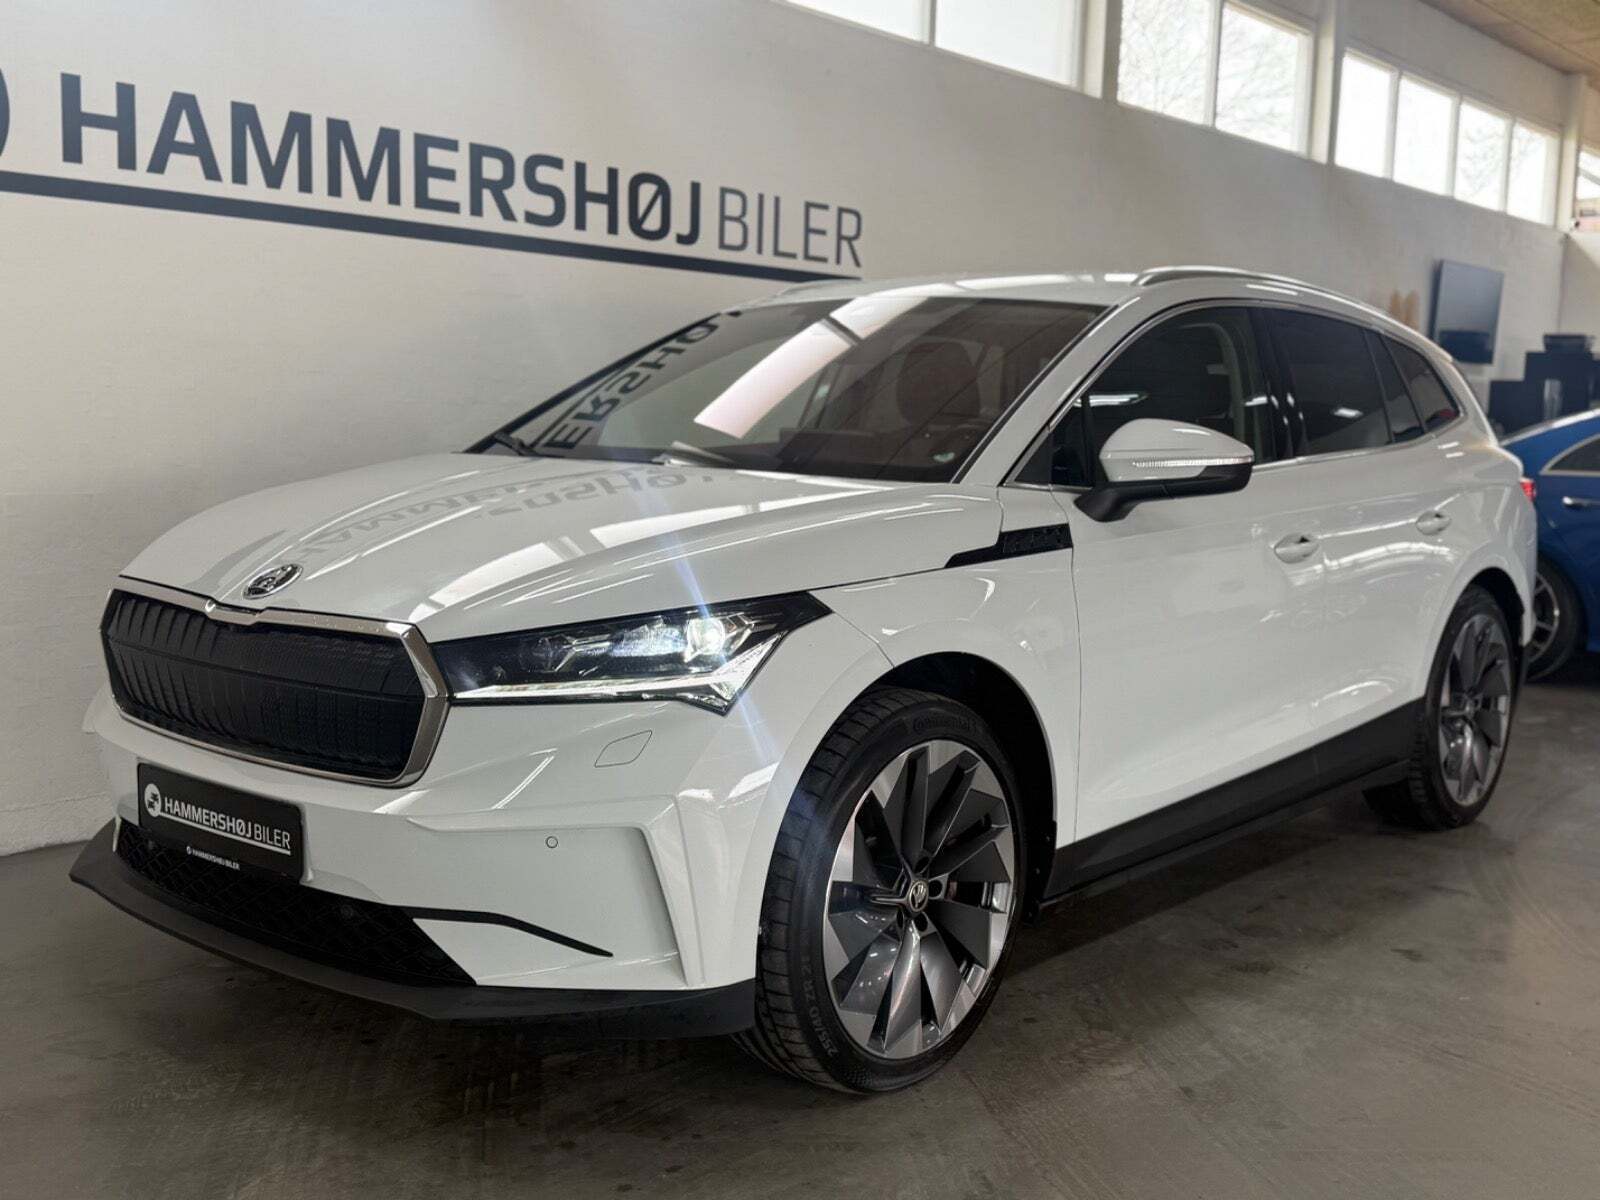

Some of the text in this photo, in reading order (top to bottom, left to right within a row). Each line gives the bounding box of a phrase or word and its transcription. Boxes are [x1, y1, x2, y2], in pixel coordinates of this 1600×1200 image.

[60, 72, 864, 269] HAMMERSHØJ BILER
[164, 796, 291, 850] HAMMERSHØJ BILER
